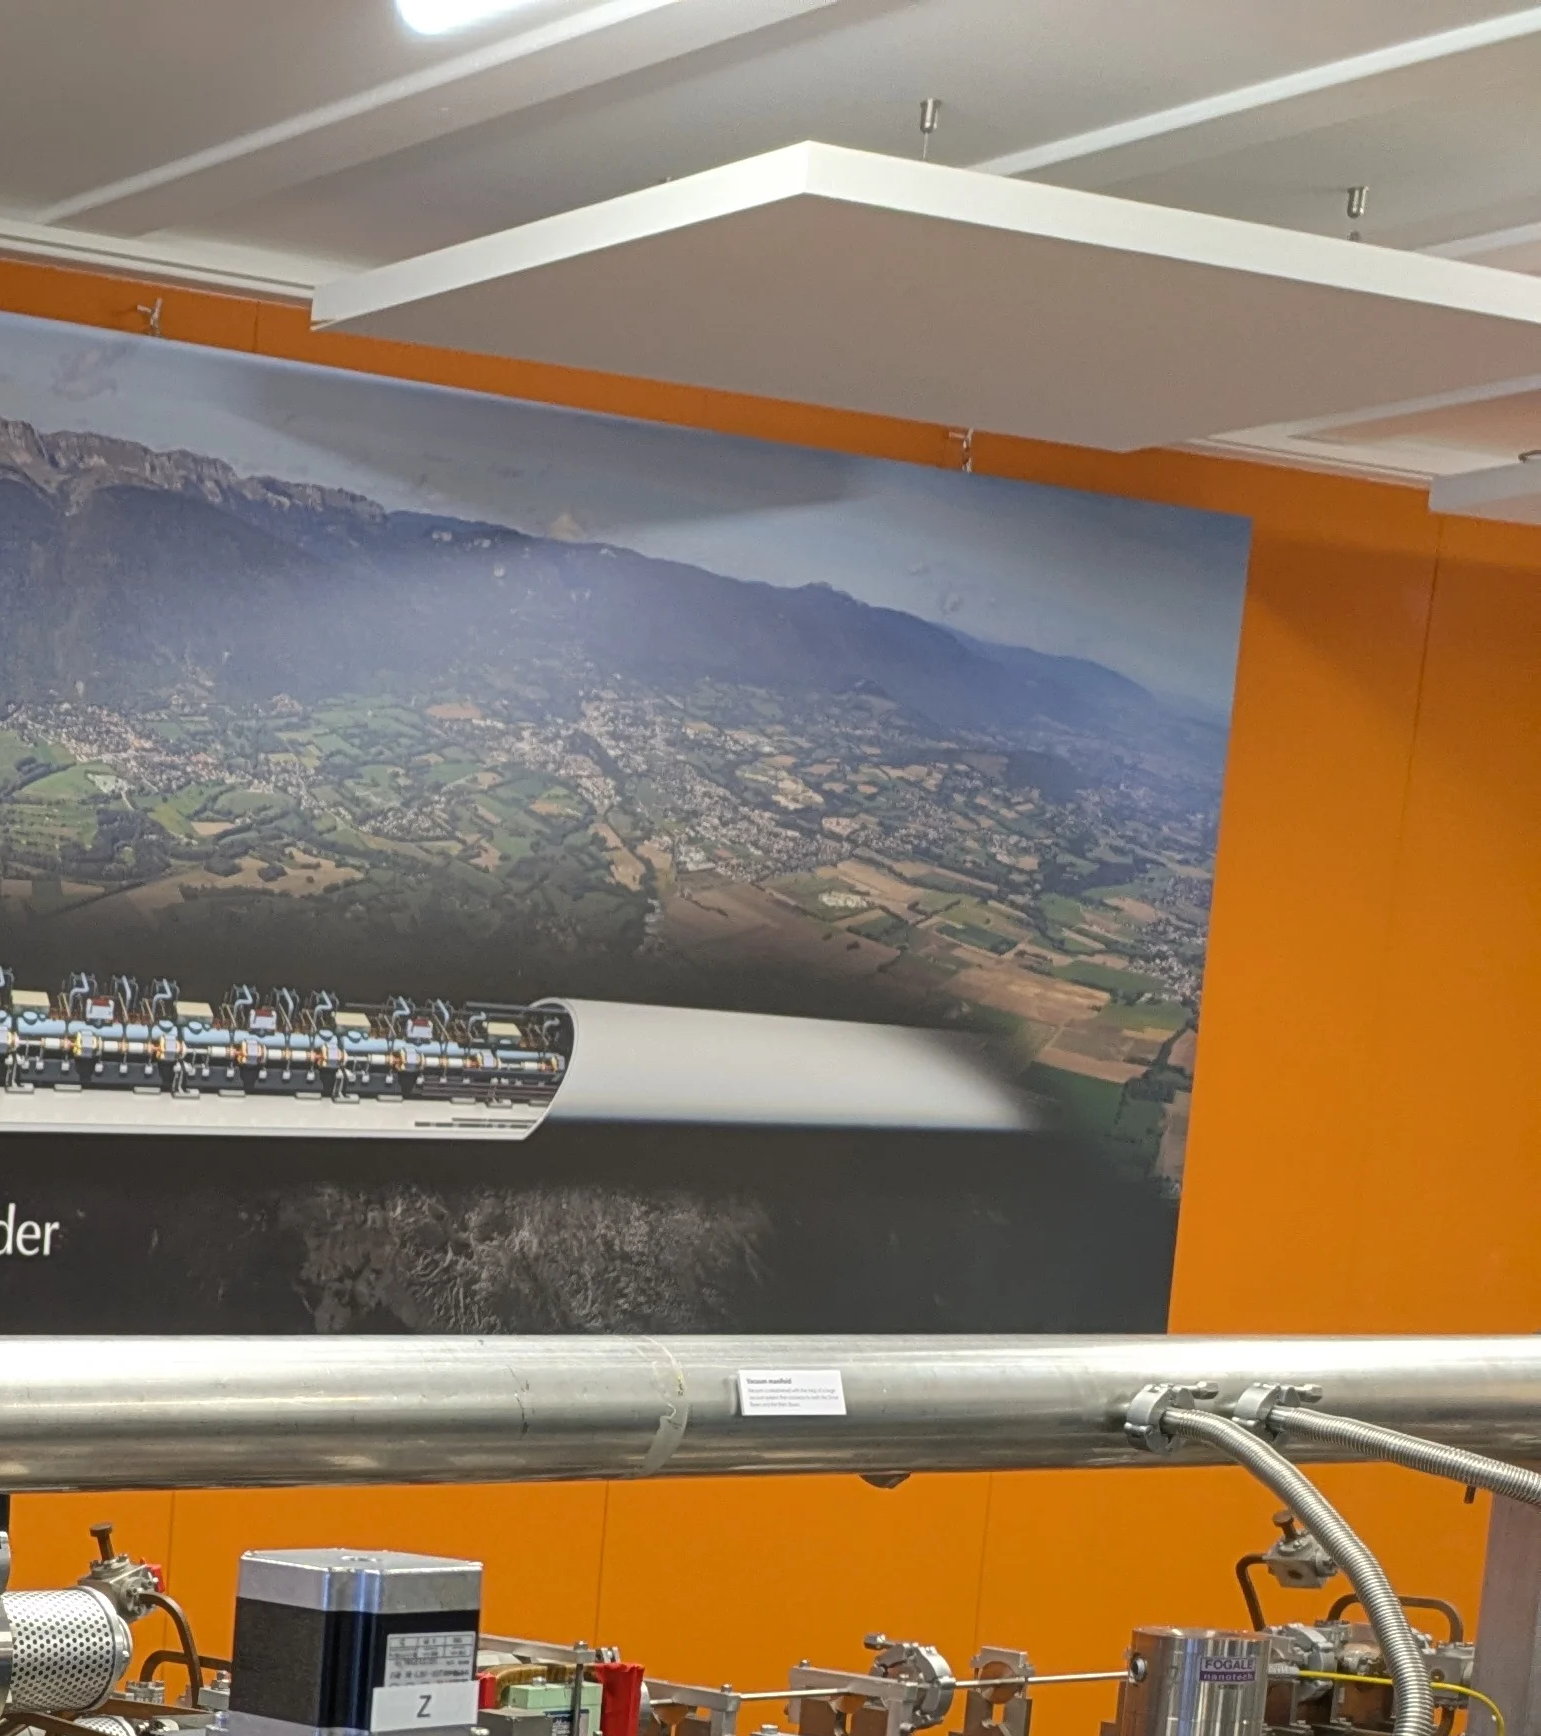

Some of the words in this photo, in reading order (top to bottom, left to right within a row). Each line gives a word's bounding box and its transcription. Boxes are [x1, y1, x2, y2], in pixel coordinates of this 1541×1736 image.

[1205, 1660, 1253, 1670] FOGALE
[1203, 1673, 1254, 1681] nanotech
[417, 1694, 432, 1719] Z
